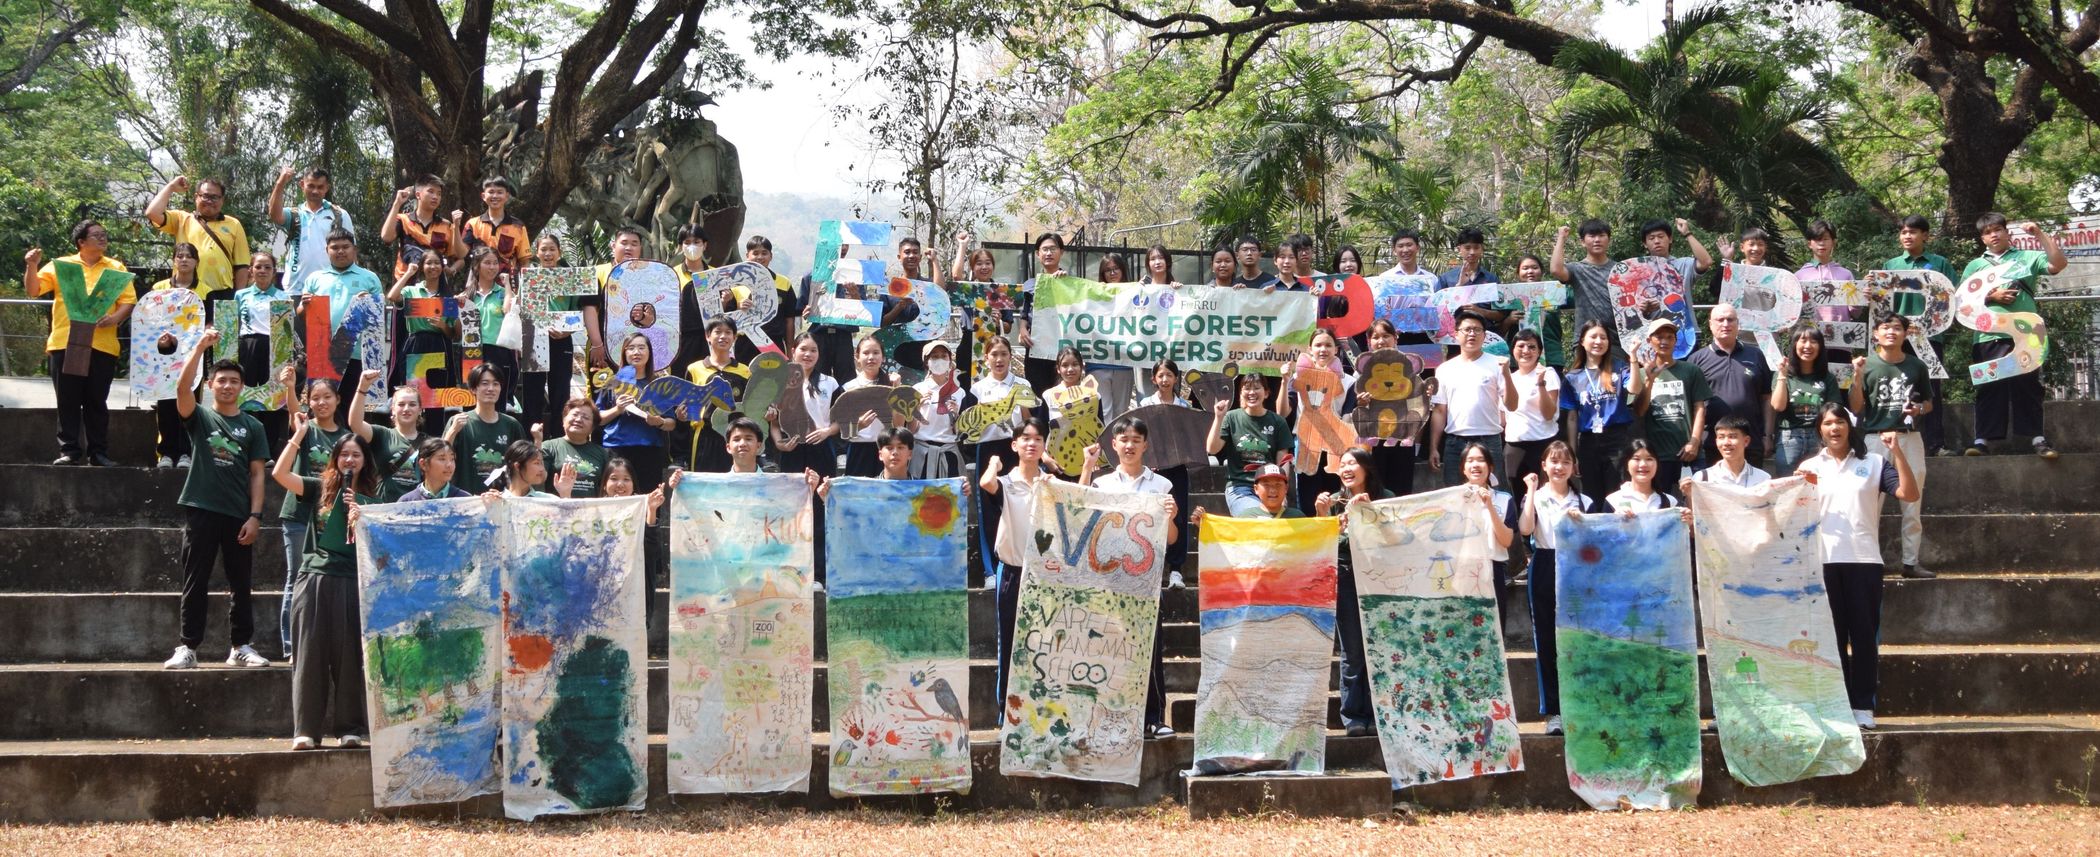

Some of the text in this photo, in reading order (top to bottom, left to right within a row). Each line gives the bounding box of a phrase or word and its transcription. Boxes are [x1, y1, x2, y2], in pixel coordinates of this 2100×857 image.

[1058, 313, 1278, 337] YOUNG FOREST
[1055, 502, 1155, 577] VCS
[755, 622, 772, 633] ZOO
[1040, 605, 1120, 635] VAREE
[1032, 652, 1124, 691] SCHOOL
